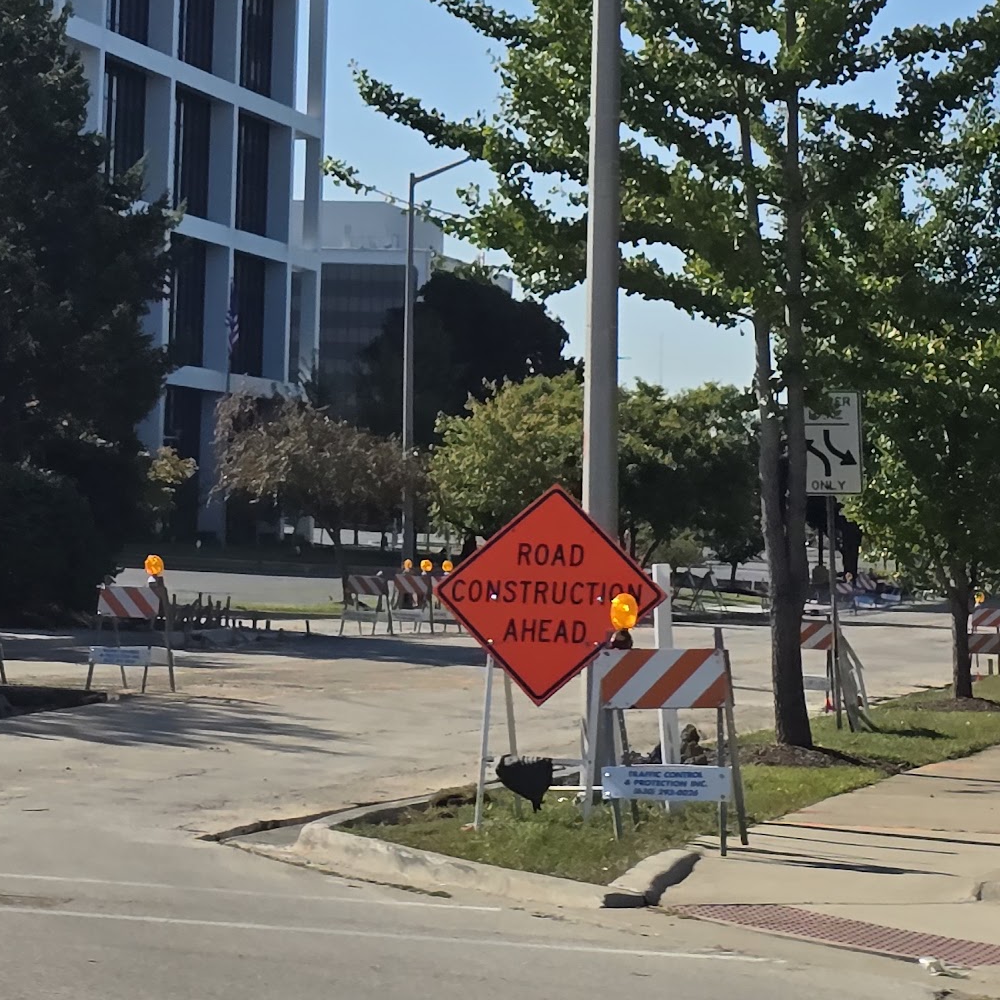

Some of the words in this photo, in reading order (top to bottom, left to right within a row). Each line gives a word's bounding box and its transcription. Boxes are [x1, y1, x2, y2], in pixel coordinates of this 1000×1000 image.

[811, 480, 846, 491] ONLY
[517, 543, 584, 567] ROAD
[503, 618, 587, 644] AHEAD
[628, 770, 662, 778] TRAFFIC
[633, 779, 687, 787] PROTECTION
